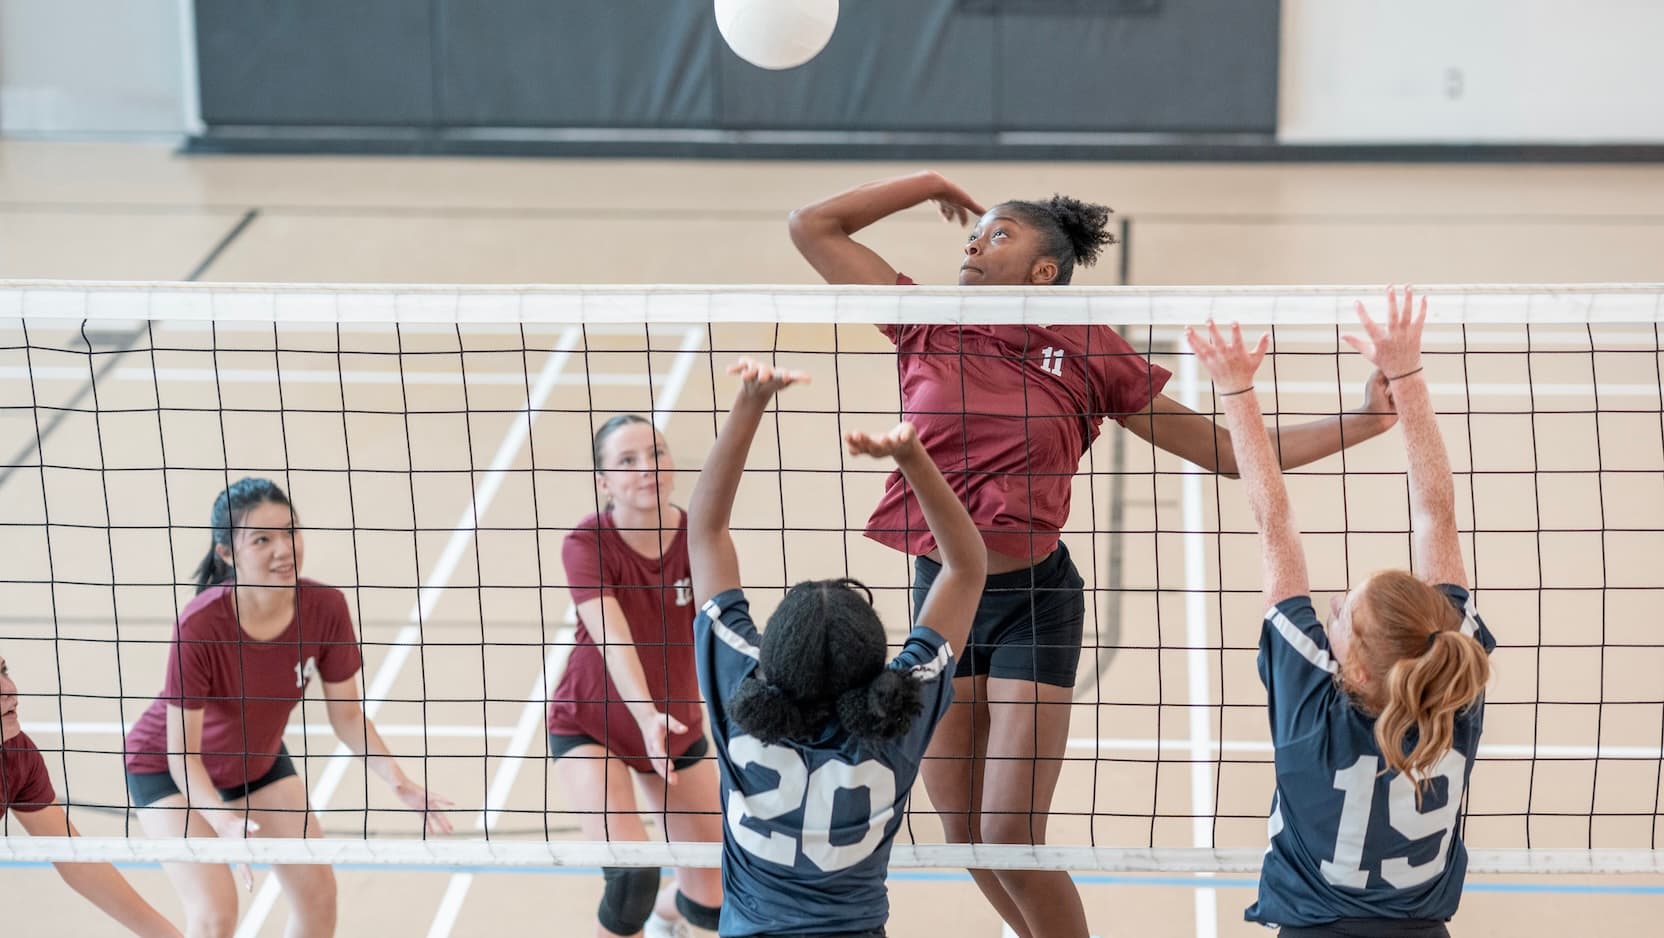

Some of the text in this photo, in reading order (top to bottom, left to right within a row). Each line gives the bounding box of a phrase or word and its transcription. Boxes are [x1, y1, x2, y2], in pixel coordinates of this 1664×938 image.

[1040, 346, 1065, 377] 11
[727, 734, 896, 872] 20
[1320, 748, 1467, 889] 19
